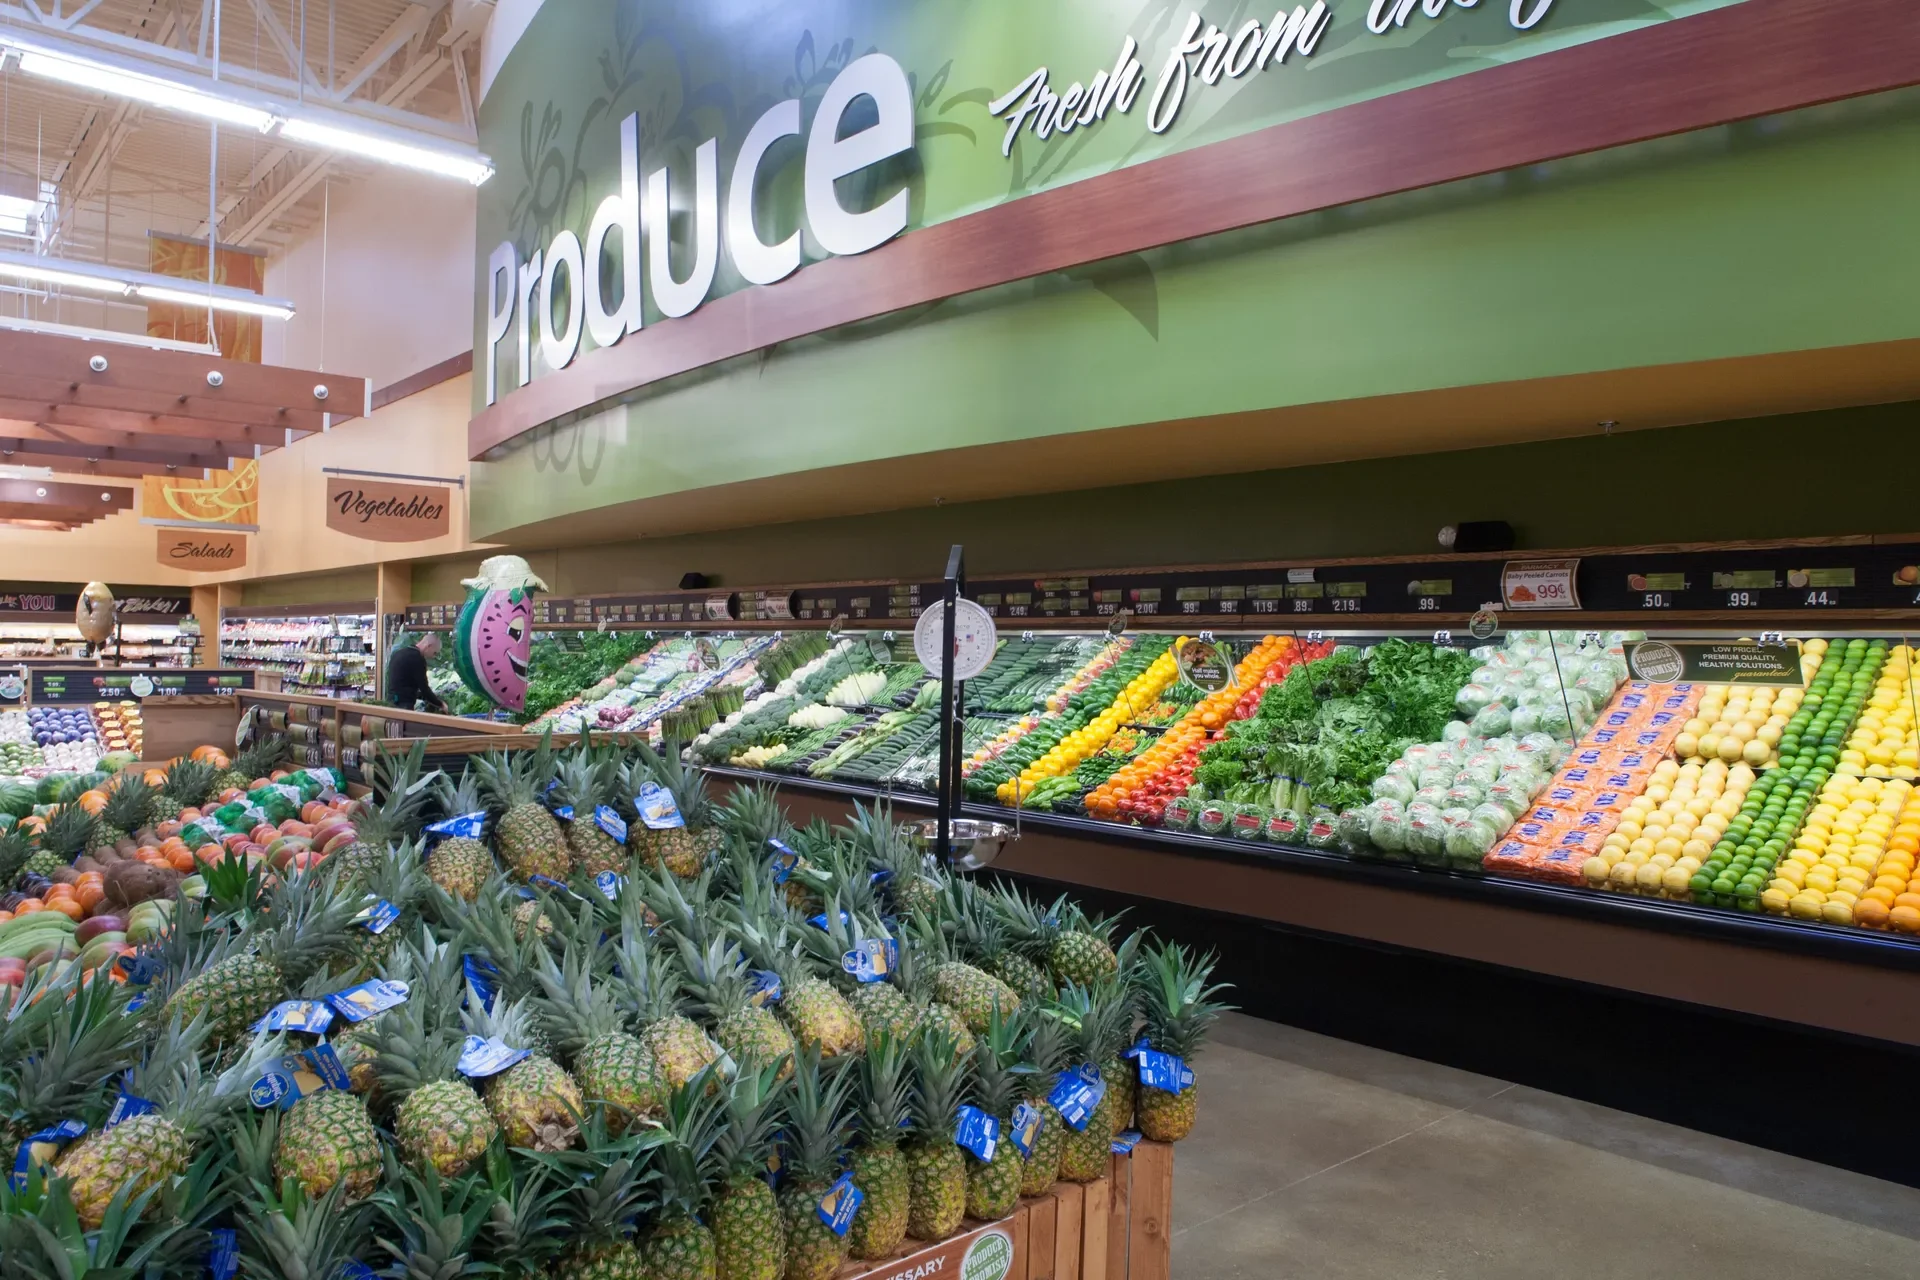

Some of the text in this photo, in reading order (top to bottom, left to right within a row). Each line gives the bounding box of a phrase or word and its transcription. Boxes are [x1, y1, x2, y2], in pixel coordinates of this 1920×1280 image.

[989, 0, 1332, 158] Fresh from
[486, 53, 915, 407] Produce
[334, 490, 443, 523] Vegetables
[170, 541, 234, 559] Salads
[1524, 571, 1545, 579] Peeled
[1545, 571, 1568, 579] Carrots
[1537, 582, 1566, 598] 99¢
[1804, 591, 1828, 605] .44
[19, 594, 55, 610] YOU
[1418, 598, 1434, 610] .99
[1642, 594, 1662, 607] .50
[1727, 592, 1750, 606] .99
[1636, 646, 1672, 663] PRODUCE
[1702, 653, 1778, 662] PREMIUM QUALITY.
[1641, 661, 1677, 677] PROMISE
[1698, 661, 1785, 670] HEALTHY SOLUTIONS.
[1730, 668, 1795, 682] guaranteed!
[967, 1238, 1003, 1272] PRODUCE
